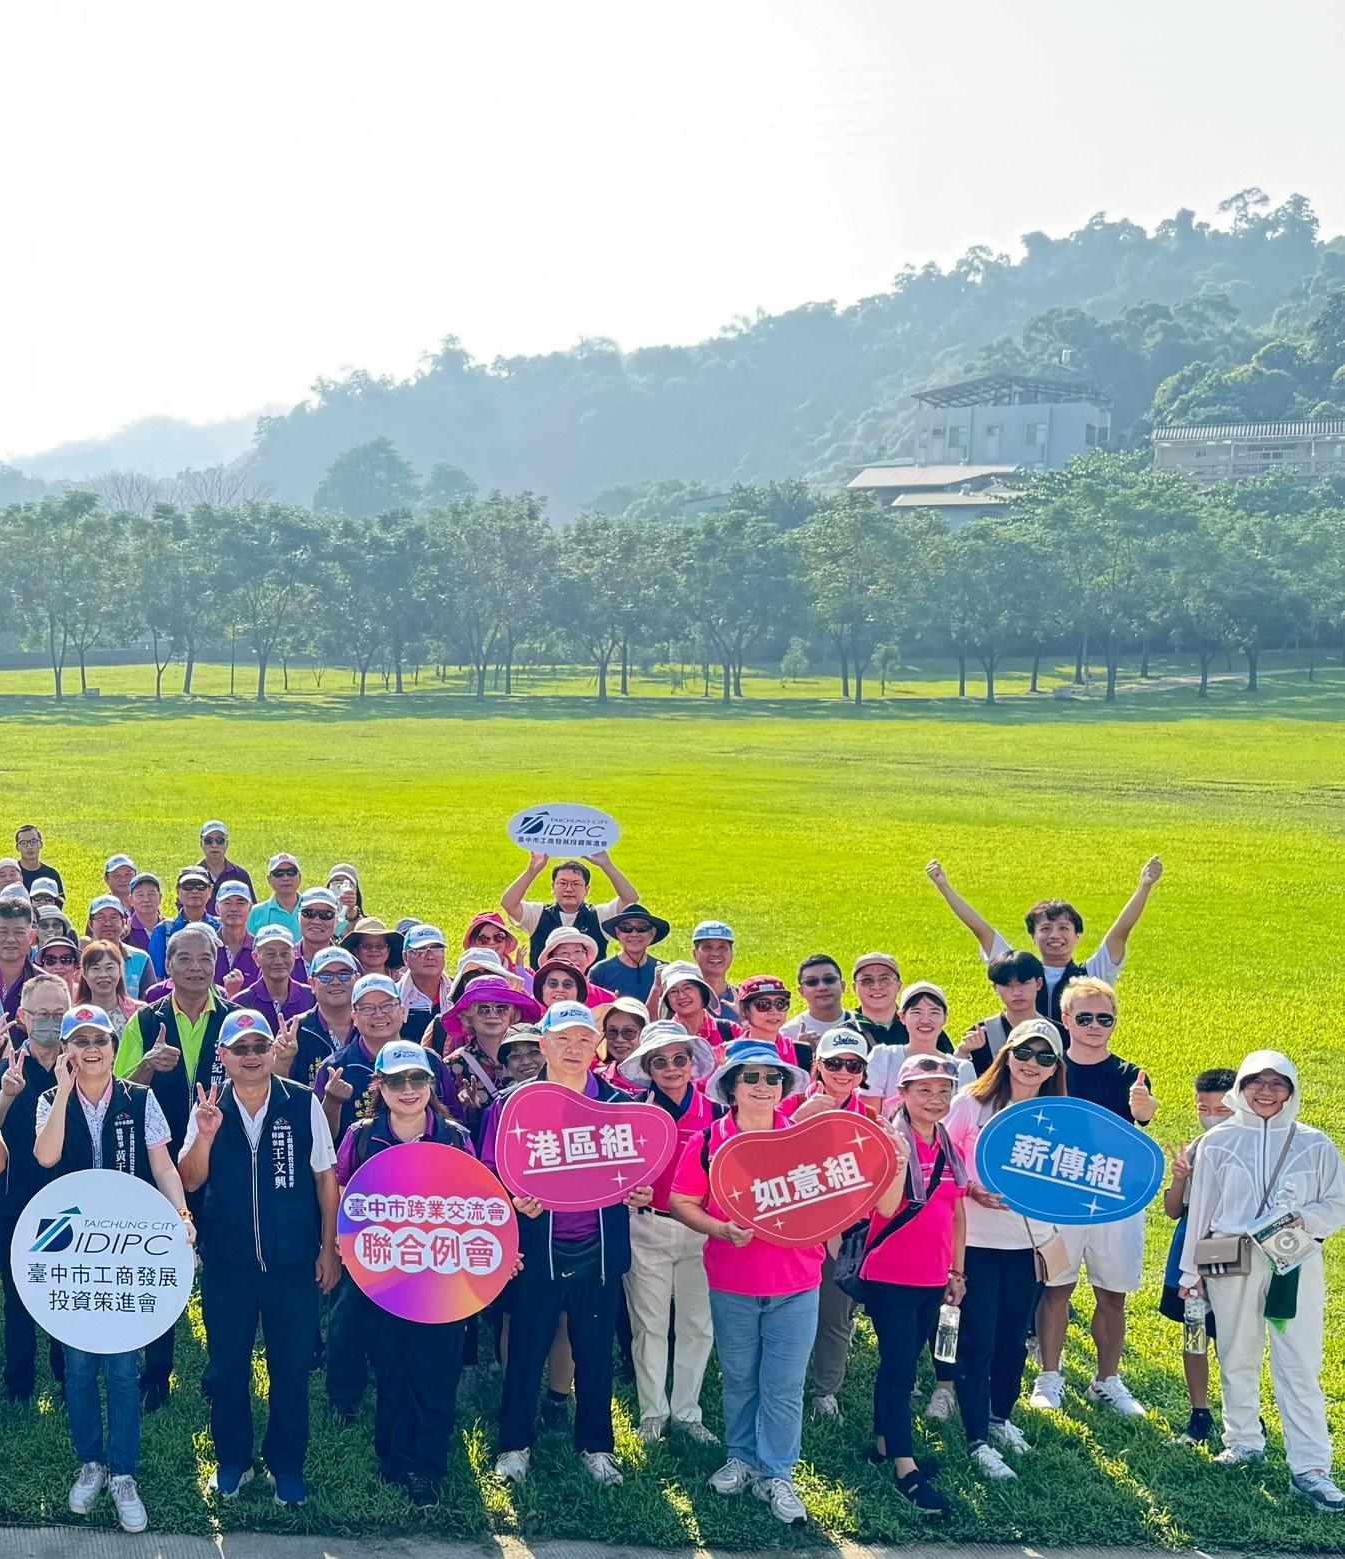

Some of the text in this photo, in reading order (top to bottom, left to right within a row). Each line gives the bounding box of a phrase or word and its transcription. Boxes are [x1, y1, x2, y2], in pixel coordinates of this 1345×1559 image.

[543, 824, 605, 838] IDIPC
[526, 1123, 638, 1169] 港區組
[272, 1147, 286, 1189] 王文興
[1010, 1133, 1125, 1193] 薪傳組
[751, 1152, 866, 1213] 如意組
[348, 1197, 505, 1221] 臺中市跨業交流會
[84, 1219, 178, 1231] TAICHUNG CITY
[74, 1232, 173, 1256] IDIPC
[361, 1232, 494, 1268] 聯合例會
[27, 1263, 178, 1288] 臺中市工商發展
[49, 1290, 157, 1313] 投資策進會
